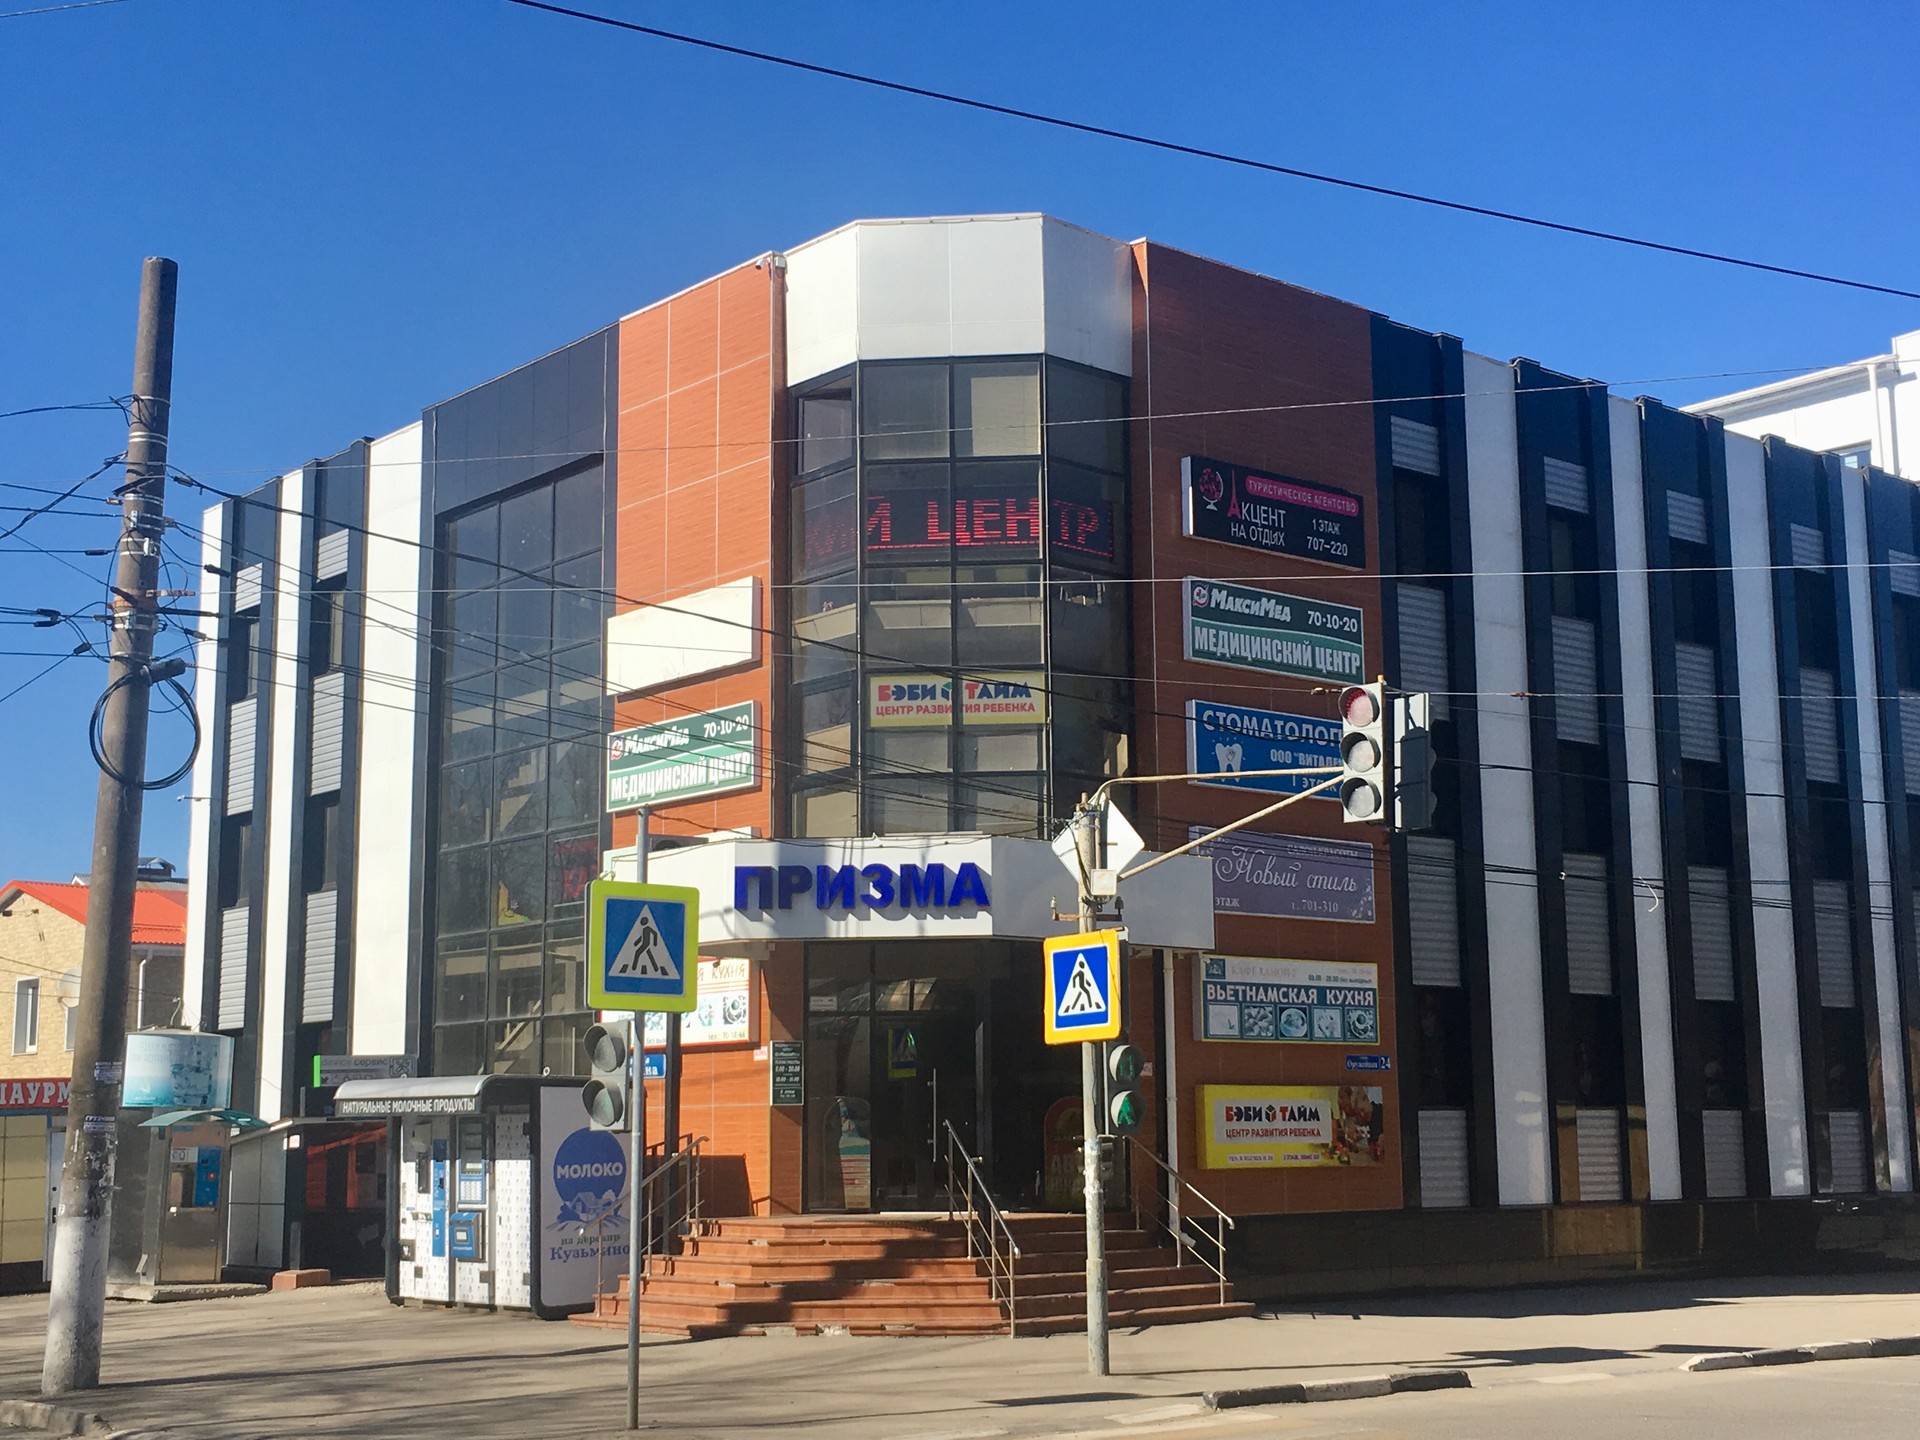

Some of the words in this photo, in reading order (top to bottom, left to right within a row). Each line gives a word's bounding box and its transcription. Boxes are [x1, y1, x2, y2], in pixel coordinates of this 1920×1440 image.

[1249, 480, 1312, 503] ТУРИСТИЧЕСКОЕ
[1314, 495, 1356, 513] АГЕНТСТВО
[1231, 523, 1247, 539] НА
[1250, 526, 1285, 547] ОТДЫХ
[1319, 519, 1341, 535] ЭТАЖ
[1307, 536, 1348, 556] 707-220
[1194, 626, 1312, 667] МЕДИЦИНСКИЙ
[1315, 646, 1361, 675] ЦЕНТР
[878, 684, 936, 702] БЭБИ
[876, 705, 913, 716] ЦЕНТР
[916, 704, 981, 715] РАЗВИИЯ
[983, 702, 1035, 713] РЕБЕНКА
[1270, 749, 1292, 764] ООО
[611, 756, 706, 802] МЕДИЦИНСКИЙ
[708, 752, 751, 786] ЦЕНТР
[1216, 845, 1301, 888] Новый
[1306, 873, 1358, 892] стиль
[734, 862, 990, 910] ПРИЗМА
[712, 964, 745, 980] КУХНЯ
[1207, 984, 1317, 1004] ВЬЕТНАМСКАЯ
[1326, 988, 1374, 1006] КУХНЯ
[342, 1101, 391, 1114] НАТУРАЛЬНЫЕ
[392, 1100, 432, 1113] МОЛОЧНЫЕ
[433, 1098, 475, 1113] ПРОДУКТЫ
[1225, 1106, 1262, 1122] БЭБИ
[1279, 1105, 1320, 1122] ТАЙМ
[1226, 1128, 1249, 1138] ЦЕНТР
[1251, 1128, 1288, 1138] РАЗВИТИЯ
[1289, 1127, 1321, 1137] РЕБЕНКА
[557, 1162, 623, 1179] МОЛОКО
